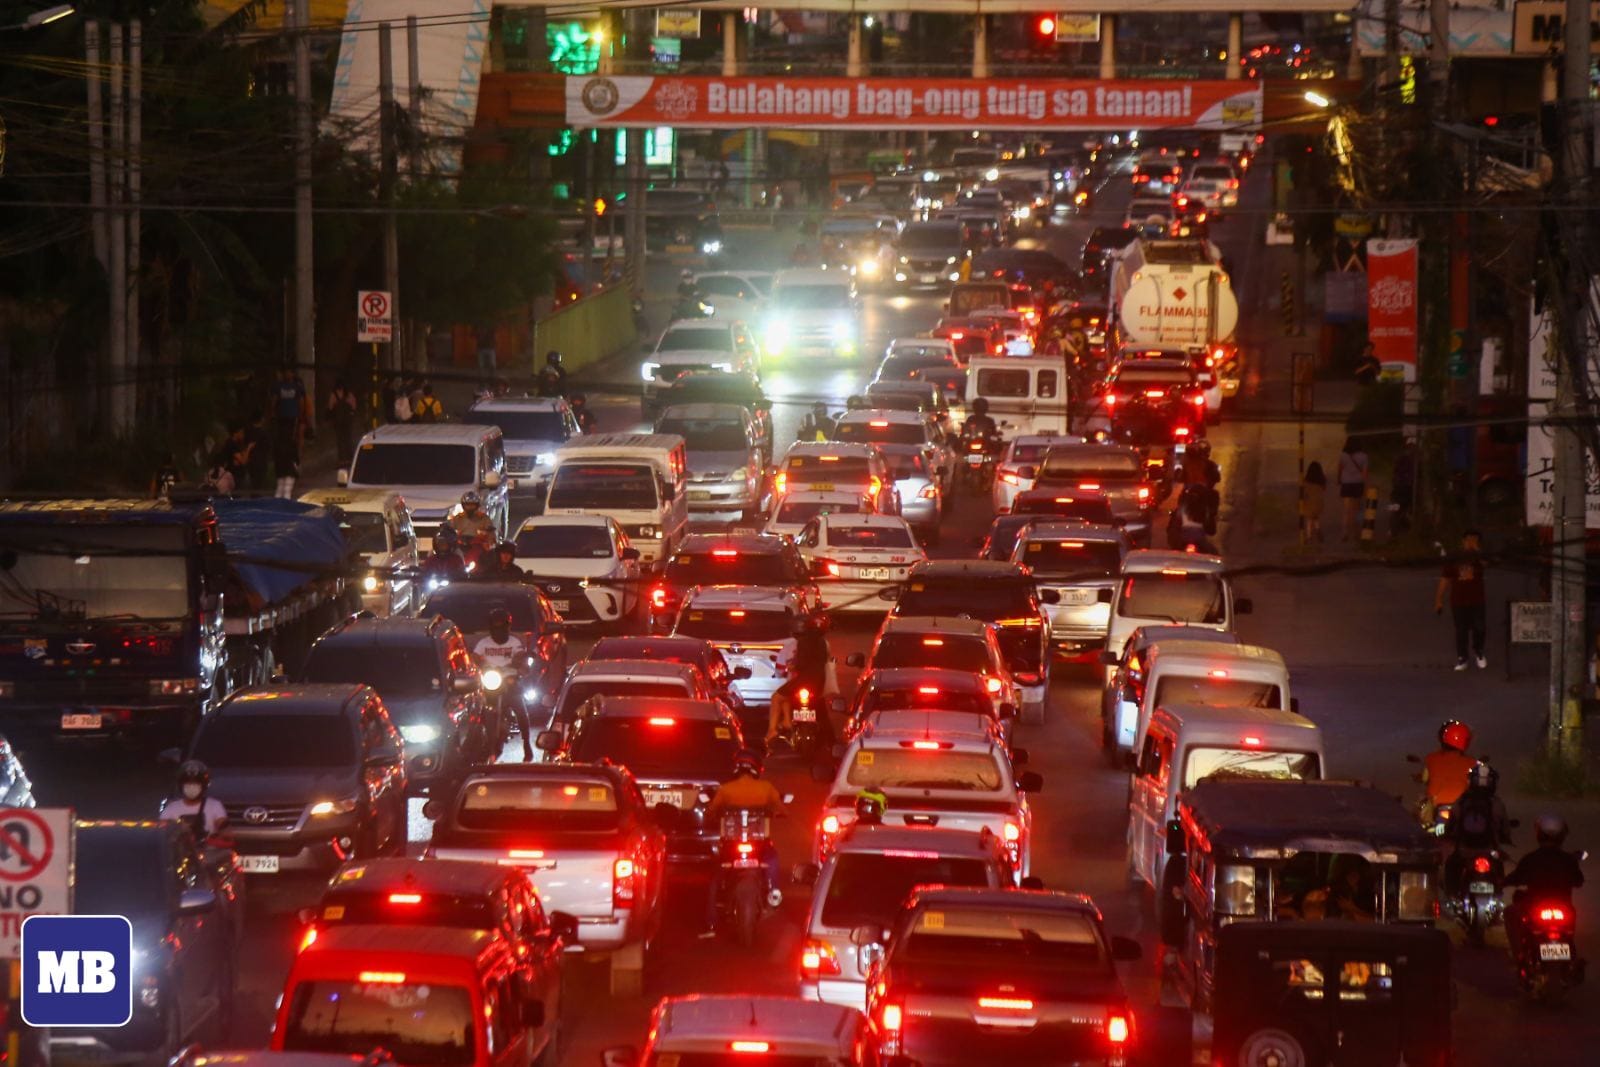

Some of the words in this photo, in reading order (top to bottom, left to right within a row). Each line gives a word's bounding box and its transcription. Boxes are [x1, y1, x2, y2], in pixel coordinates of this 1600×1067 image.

[707, 82, 849, 118] Bulahang
[857, 82, 980, 119] bag-ong
[987, 85, 1046, 118] tuig
[1053, 88, 1088, 116] sa
[1095, 85, 1192, 117] tanan!
